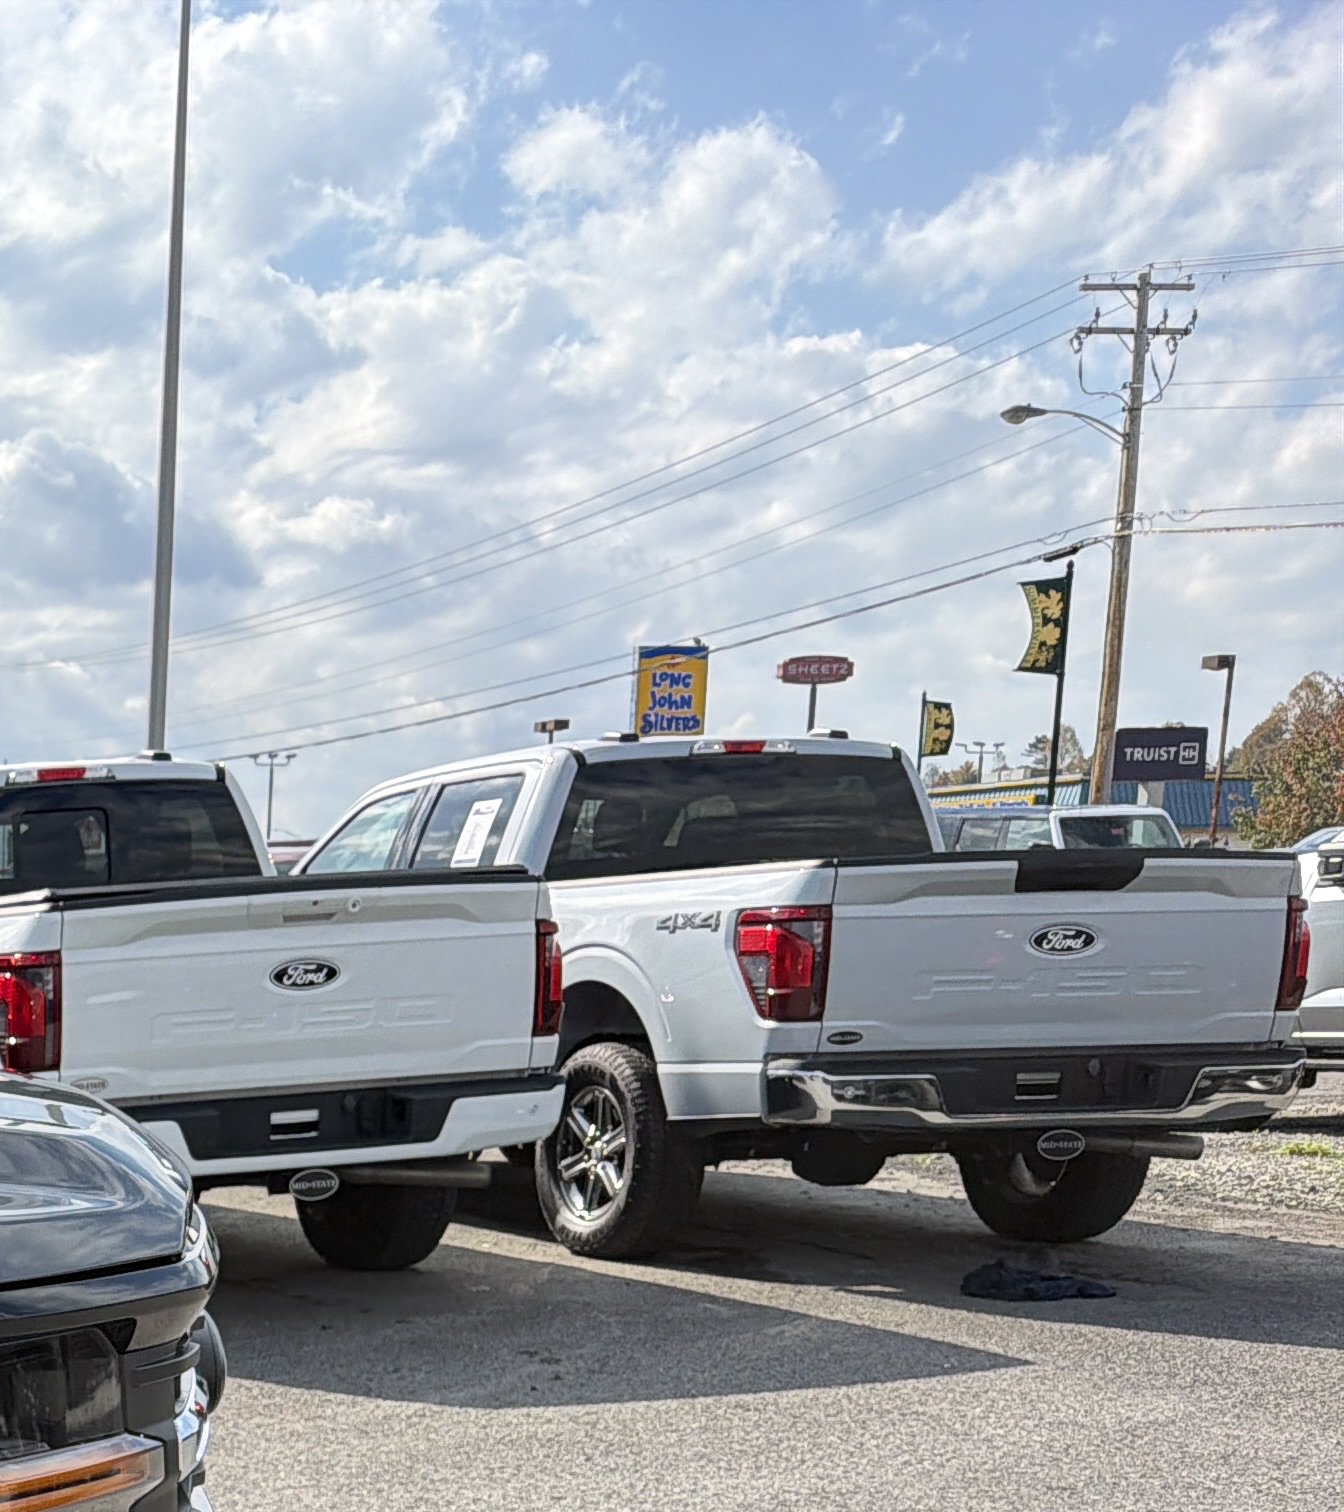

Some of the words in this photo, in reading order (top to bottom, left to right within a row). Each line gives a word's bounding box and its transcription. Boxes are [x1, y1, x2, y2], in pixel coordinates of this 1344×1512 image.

[788, 662, 849, 675] SHEETZ
[1124, 746, 1178, 762] TRUIST
[1042, 930, 1087, 950] Ford
[283, 964, 329, 986] Ford
